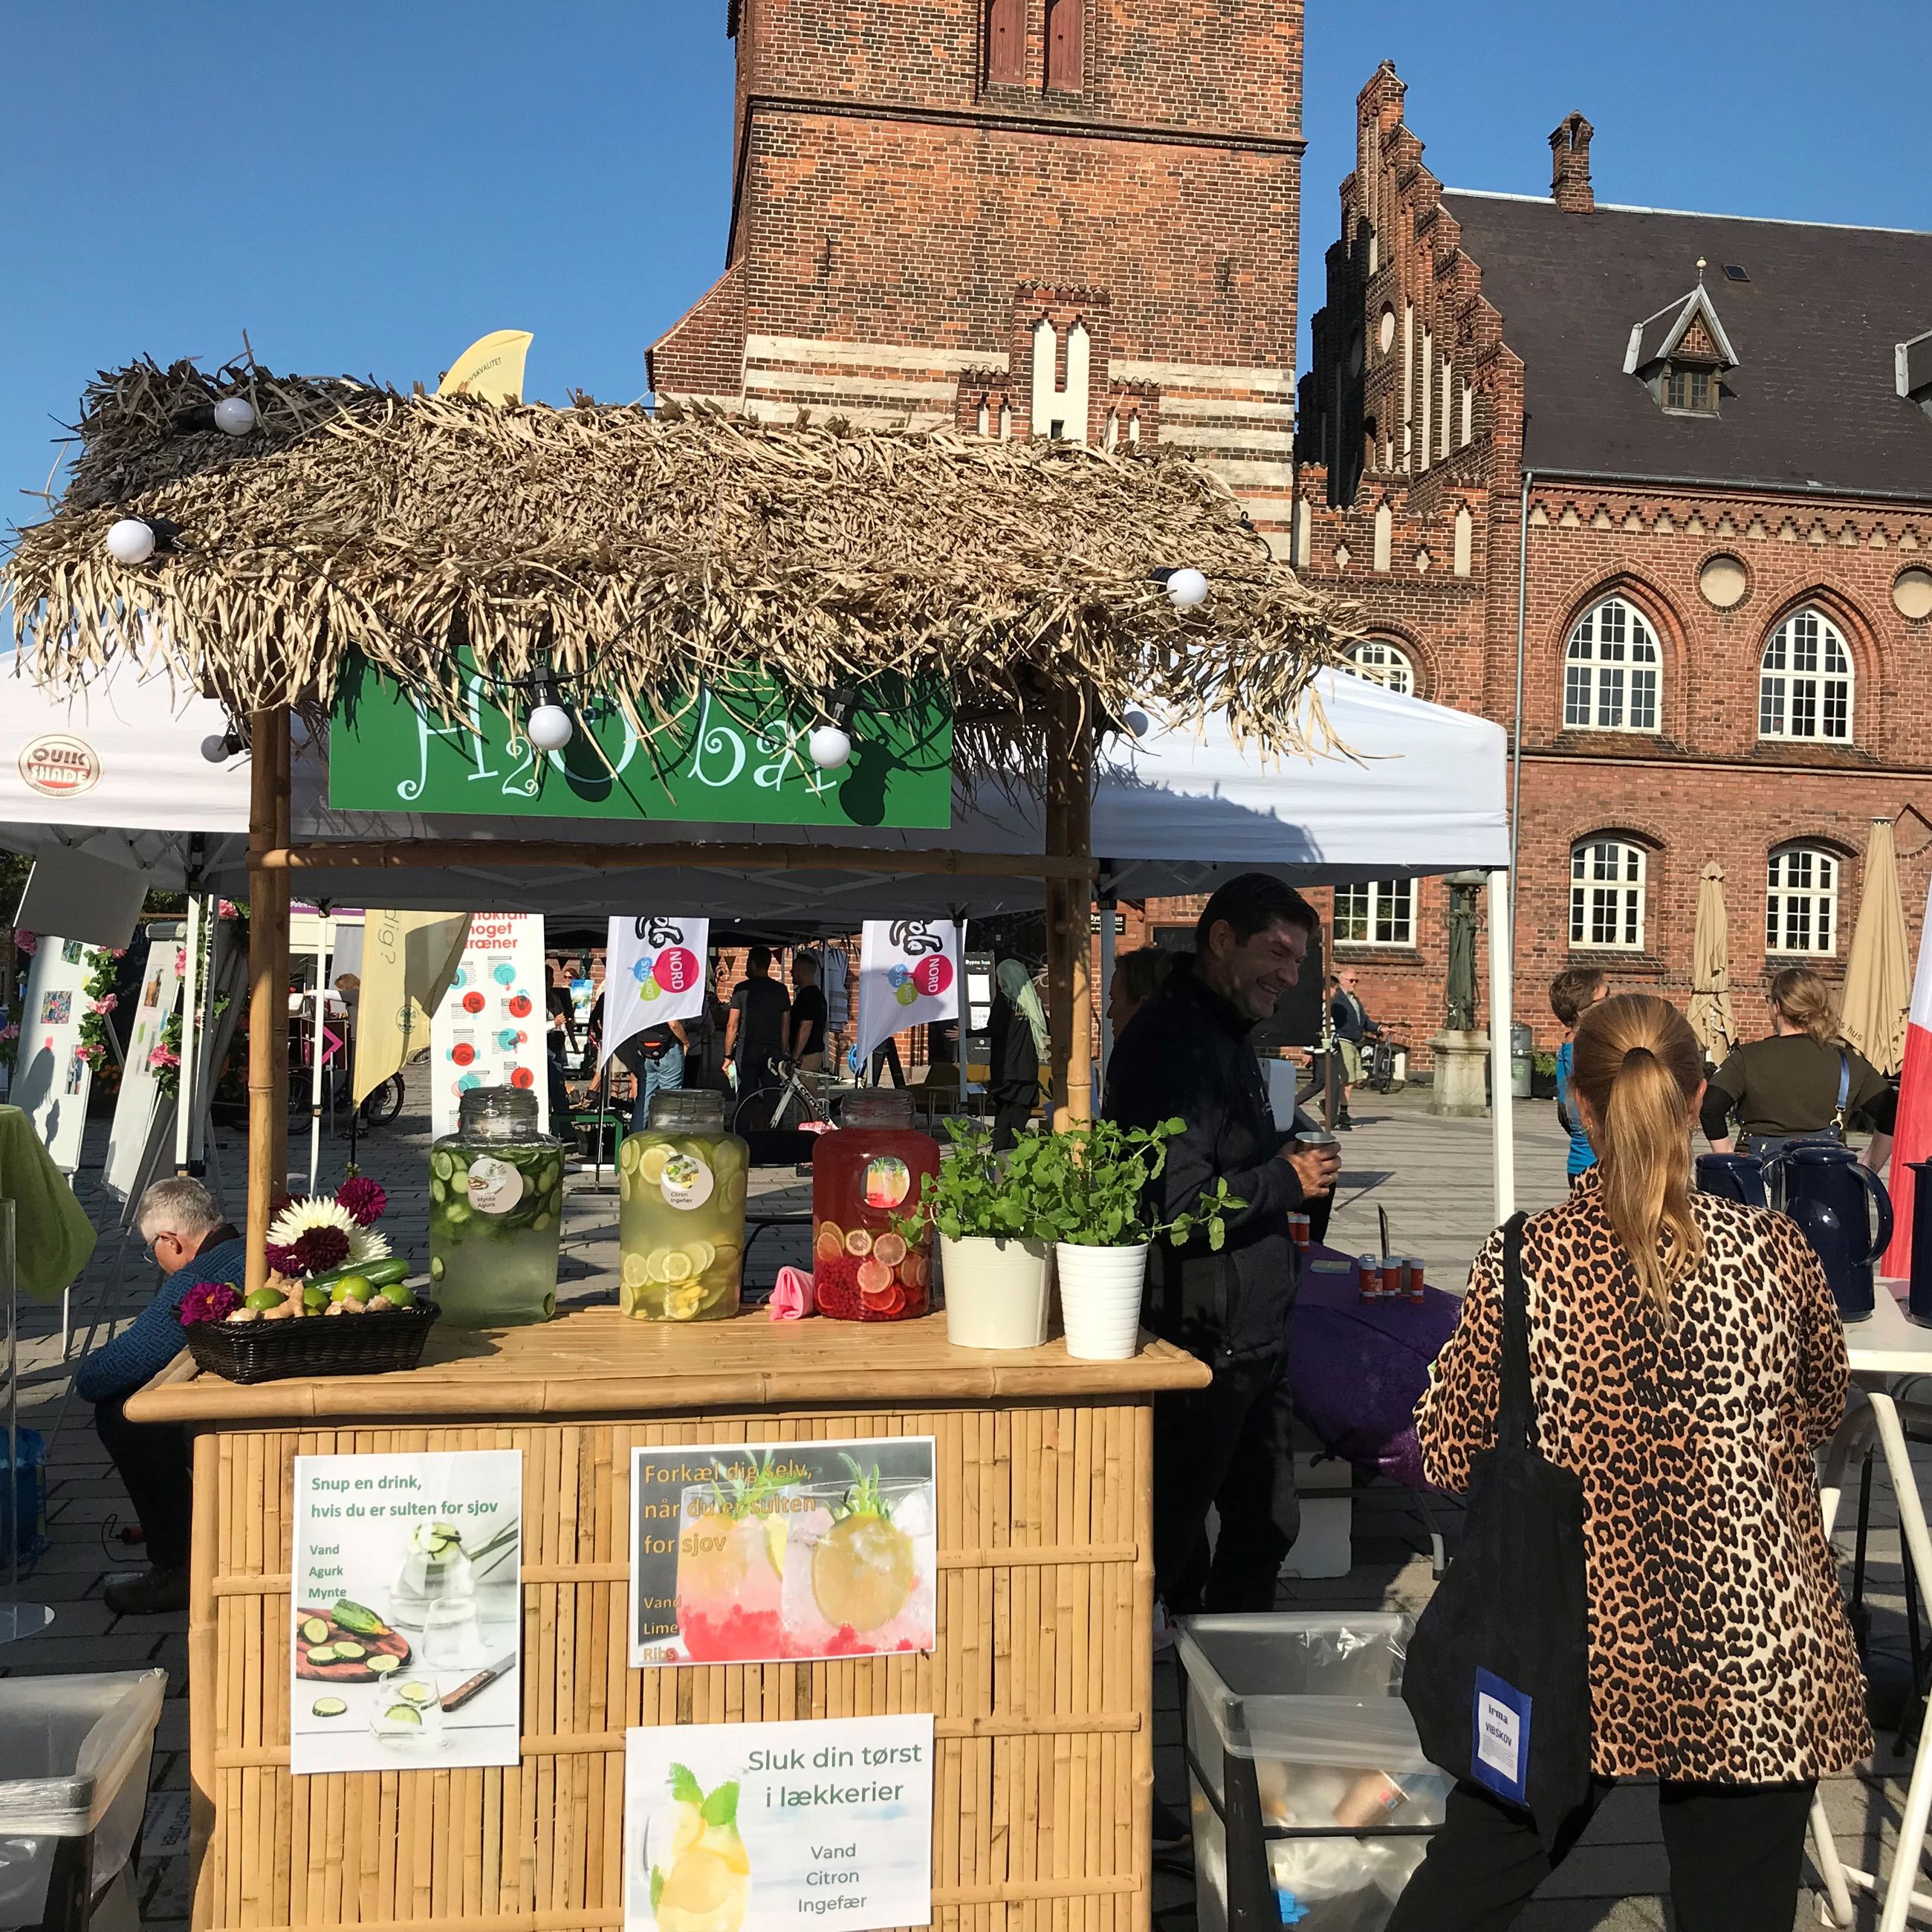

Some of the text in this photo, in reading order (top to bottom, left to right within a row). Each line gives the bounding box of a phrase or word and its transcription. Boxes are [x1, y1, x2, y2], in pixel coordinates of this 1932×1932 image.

[32, 748, 87, 765] QUIK
[30, 765, 87, 785] SHADE
[641, 960, 650, 980] SYD
[670, 950, 684, 990] NORD
[895, 967, 904, 986] SYD
[929, 958, 939, 993] NORD
[1847, 1025, 1863, 1042] hus
[644, 1459, 814, 1485] Forkæl dig selv,
[311, 1475, 422, 1494] Snup en drink,
[311, 1500, 499, 1518] hvis du er sulten for sjov
[644, 1494, 817, 1519] når du er sulten
[309, 1543, 340, 1555] Vand
[644, 1532, 727, 1557] for sjov
[308, 1565, 344, 1579] Agurk
[308, 1587, 347, 1600] Mynte
[643, 1595, 682, 1610] Vand
[643, 1621, 679, 1635] Lime
[644, 1646, 675, 1662] Ribs
[1485, 1722, 1511, 1746] VIBSKOV
[748, 1744, 922, 1771] Sluk din tørst
[766, 1780, 904, 1807] i lækkerier
[811, 1843, 856, 1859] Vand
[806, 1870, 860, 1886] Citron
[798, 1895, 867, 1914] Ingefær
